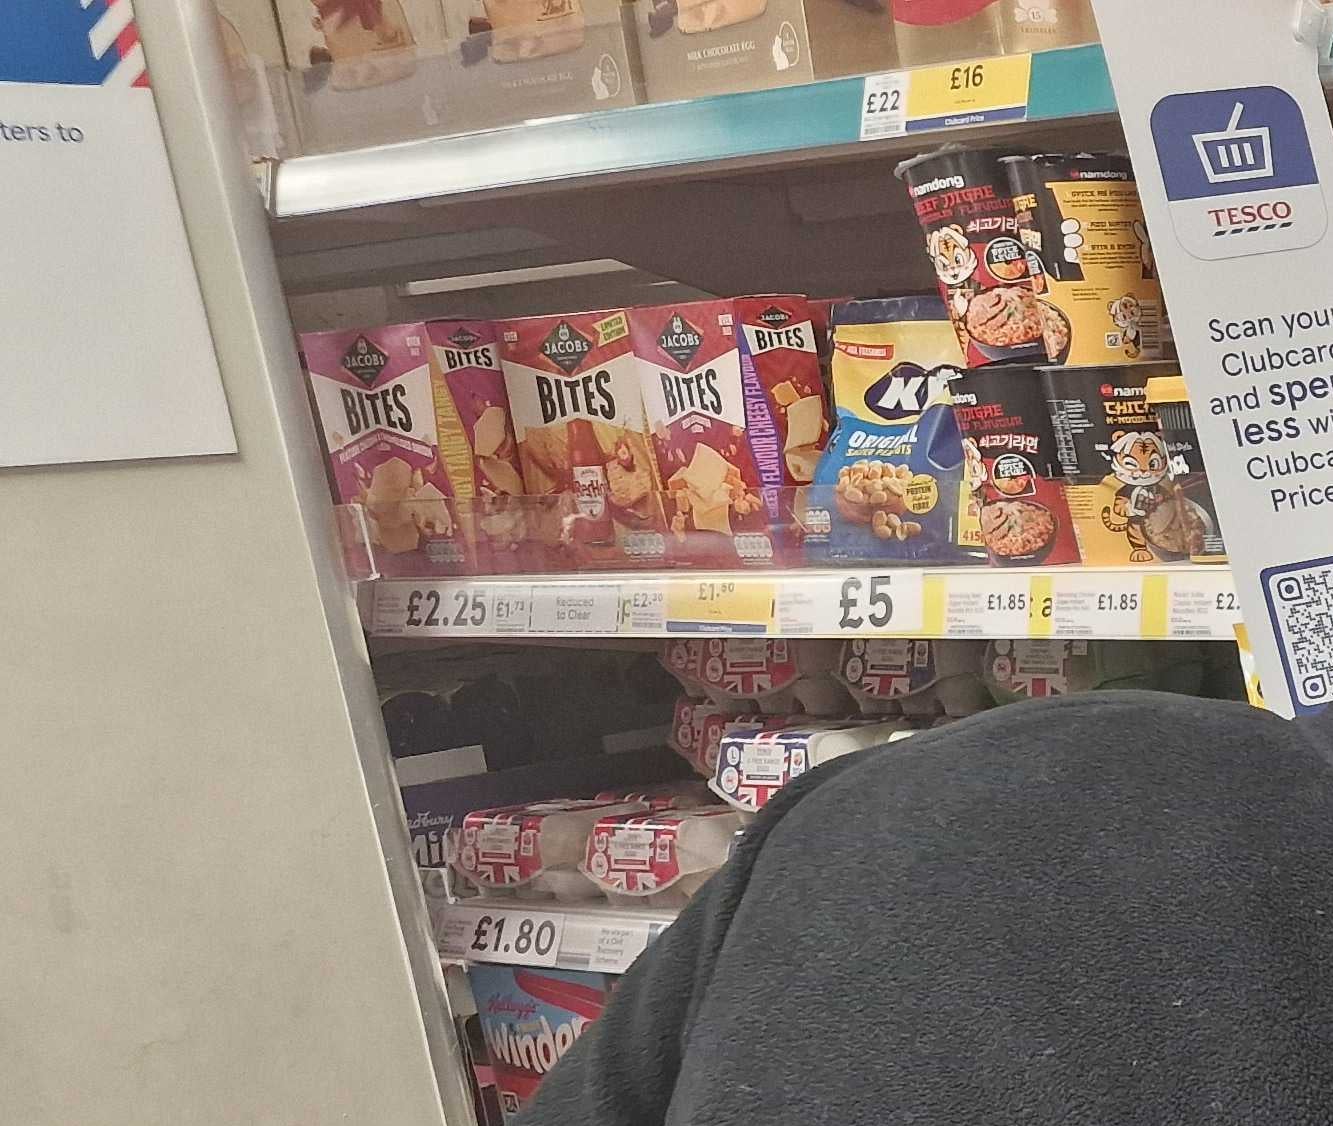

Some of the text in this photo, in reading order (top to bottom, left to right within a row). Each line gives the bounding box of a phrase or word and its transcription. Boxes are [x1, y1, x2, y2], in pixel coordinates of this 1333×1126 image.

[950, 65, 983, 90] £16
[867, 90, 900, 113] £22
[56, 123, 83, 142] to
[1079, 170, 1128, 180] namdong
[1208, 201, 1292, 228] TESCO
[755, 327, 805, 350] BITES
[1209, 313, 1277, 343] Scan
[445, 346, 493, 369] BITES
[535, 371, 617, 423] BITES
[660, 368, 723, 417] BITES
[1210, 389, 1262, 416] and
[340, 385, 413, 435] BITES
[1232, 414, 1301, 447] less
[406, 590, 486, 626] £2.25
[839, 576, 893, 629] £5
[986, 591, 1026, 612] £1.85
[1097, 592, 1138, 613] £1.85
[471, 915, 556, 956] £1.80
